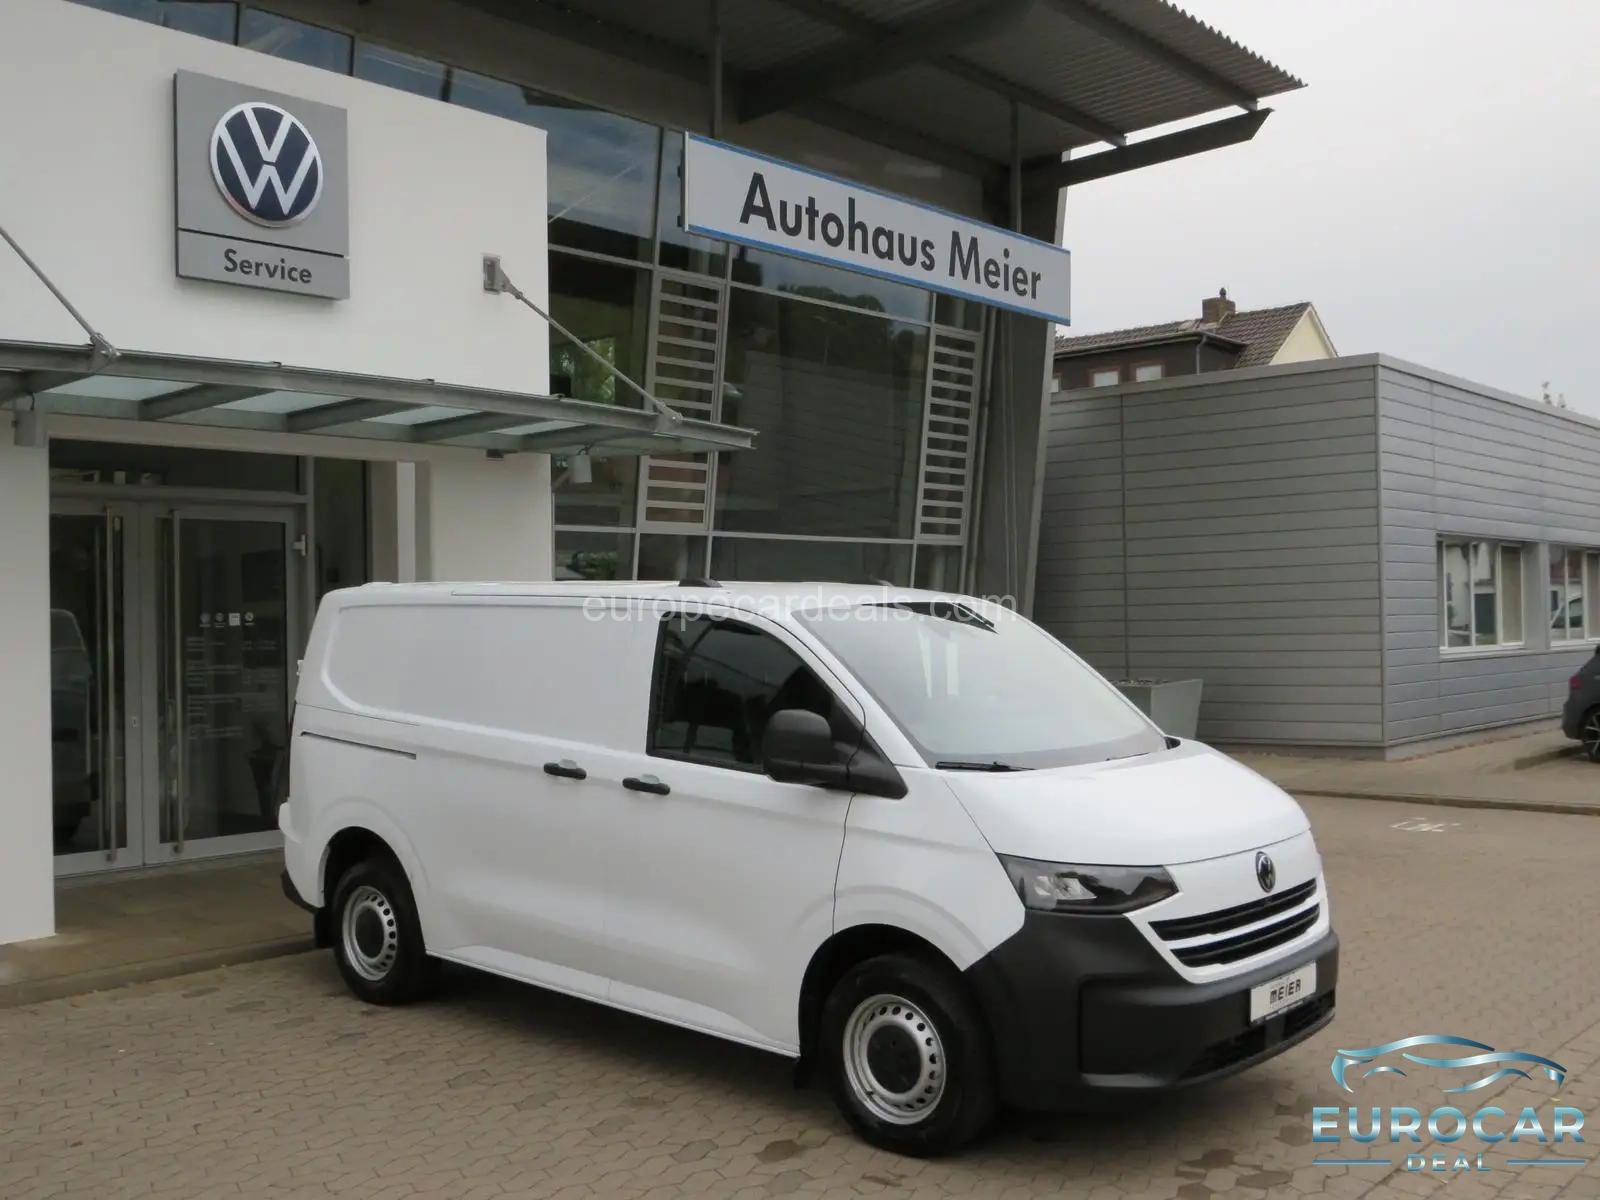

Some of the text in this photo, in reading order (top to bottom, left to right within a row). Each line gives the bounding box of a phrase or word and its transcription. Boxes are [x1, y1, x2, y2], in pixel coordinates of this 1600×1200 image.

[214, 105, 320, 220] VW
[223, 248, 313, 285] Service
[739, 171, 1042, 300] Autohaus Meier
